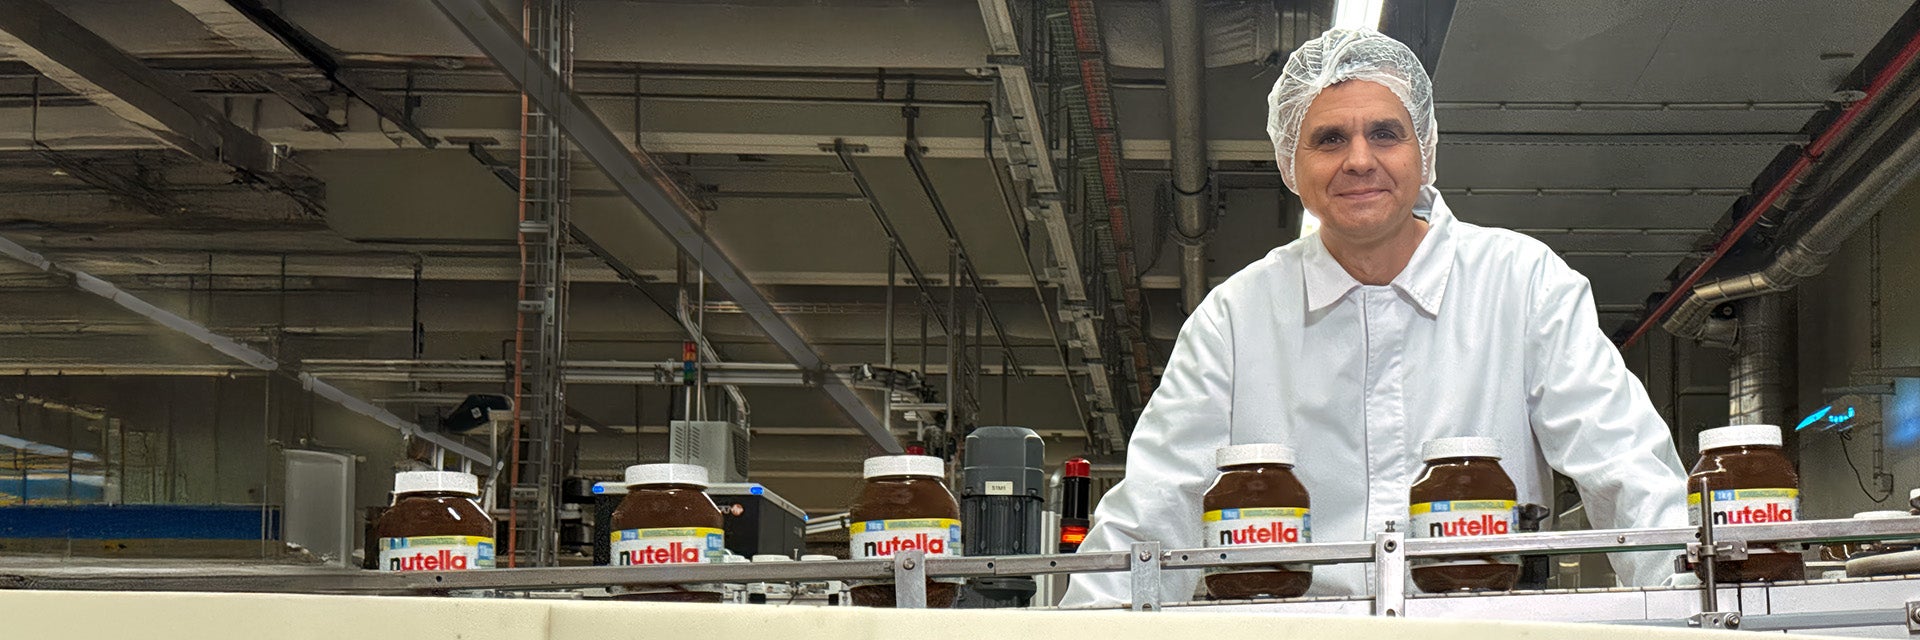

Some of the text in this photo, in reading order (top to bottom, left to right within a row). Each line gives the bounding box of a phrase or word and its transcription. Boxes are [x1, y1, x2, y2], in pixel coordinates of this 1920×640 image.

[1713, 502, 1793, 525] nutella
[1220, 521, 1299, 545] nutella
[1429, 514, 1508, 537] nutella
[619, 541, 700, 566] nutella
[864, 533, 944, 557] nutella
[390, 549, 468, 571] nutella
